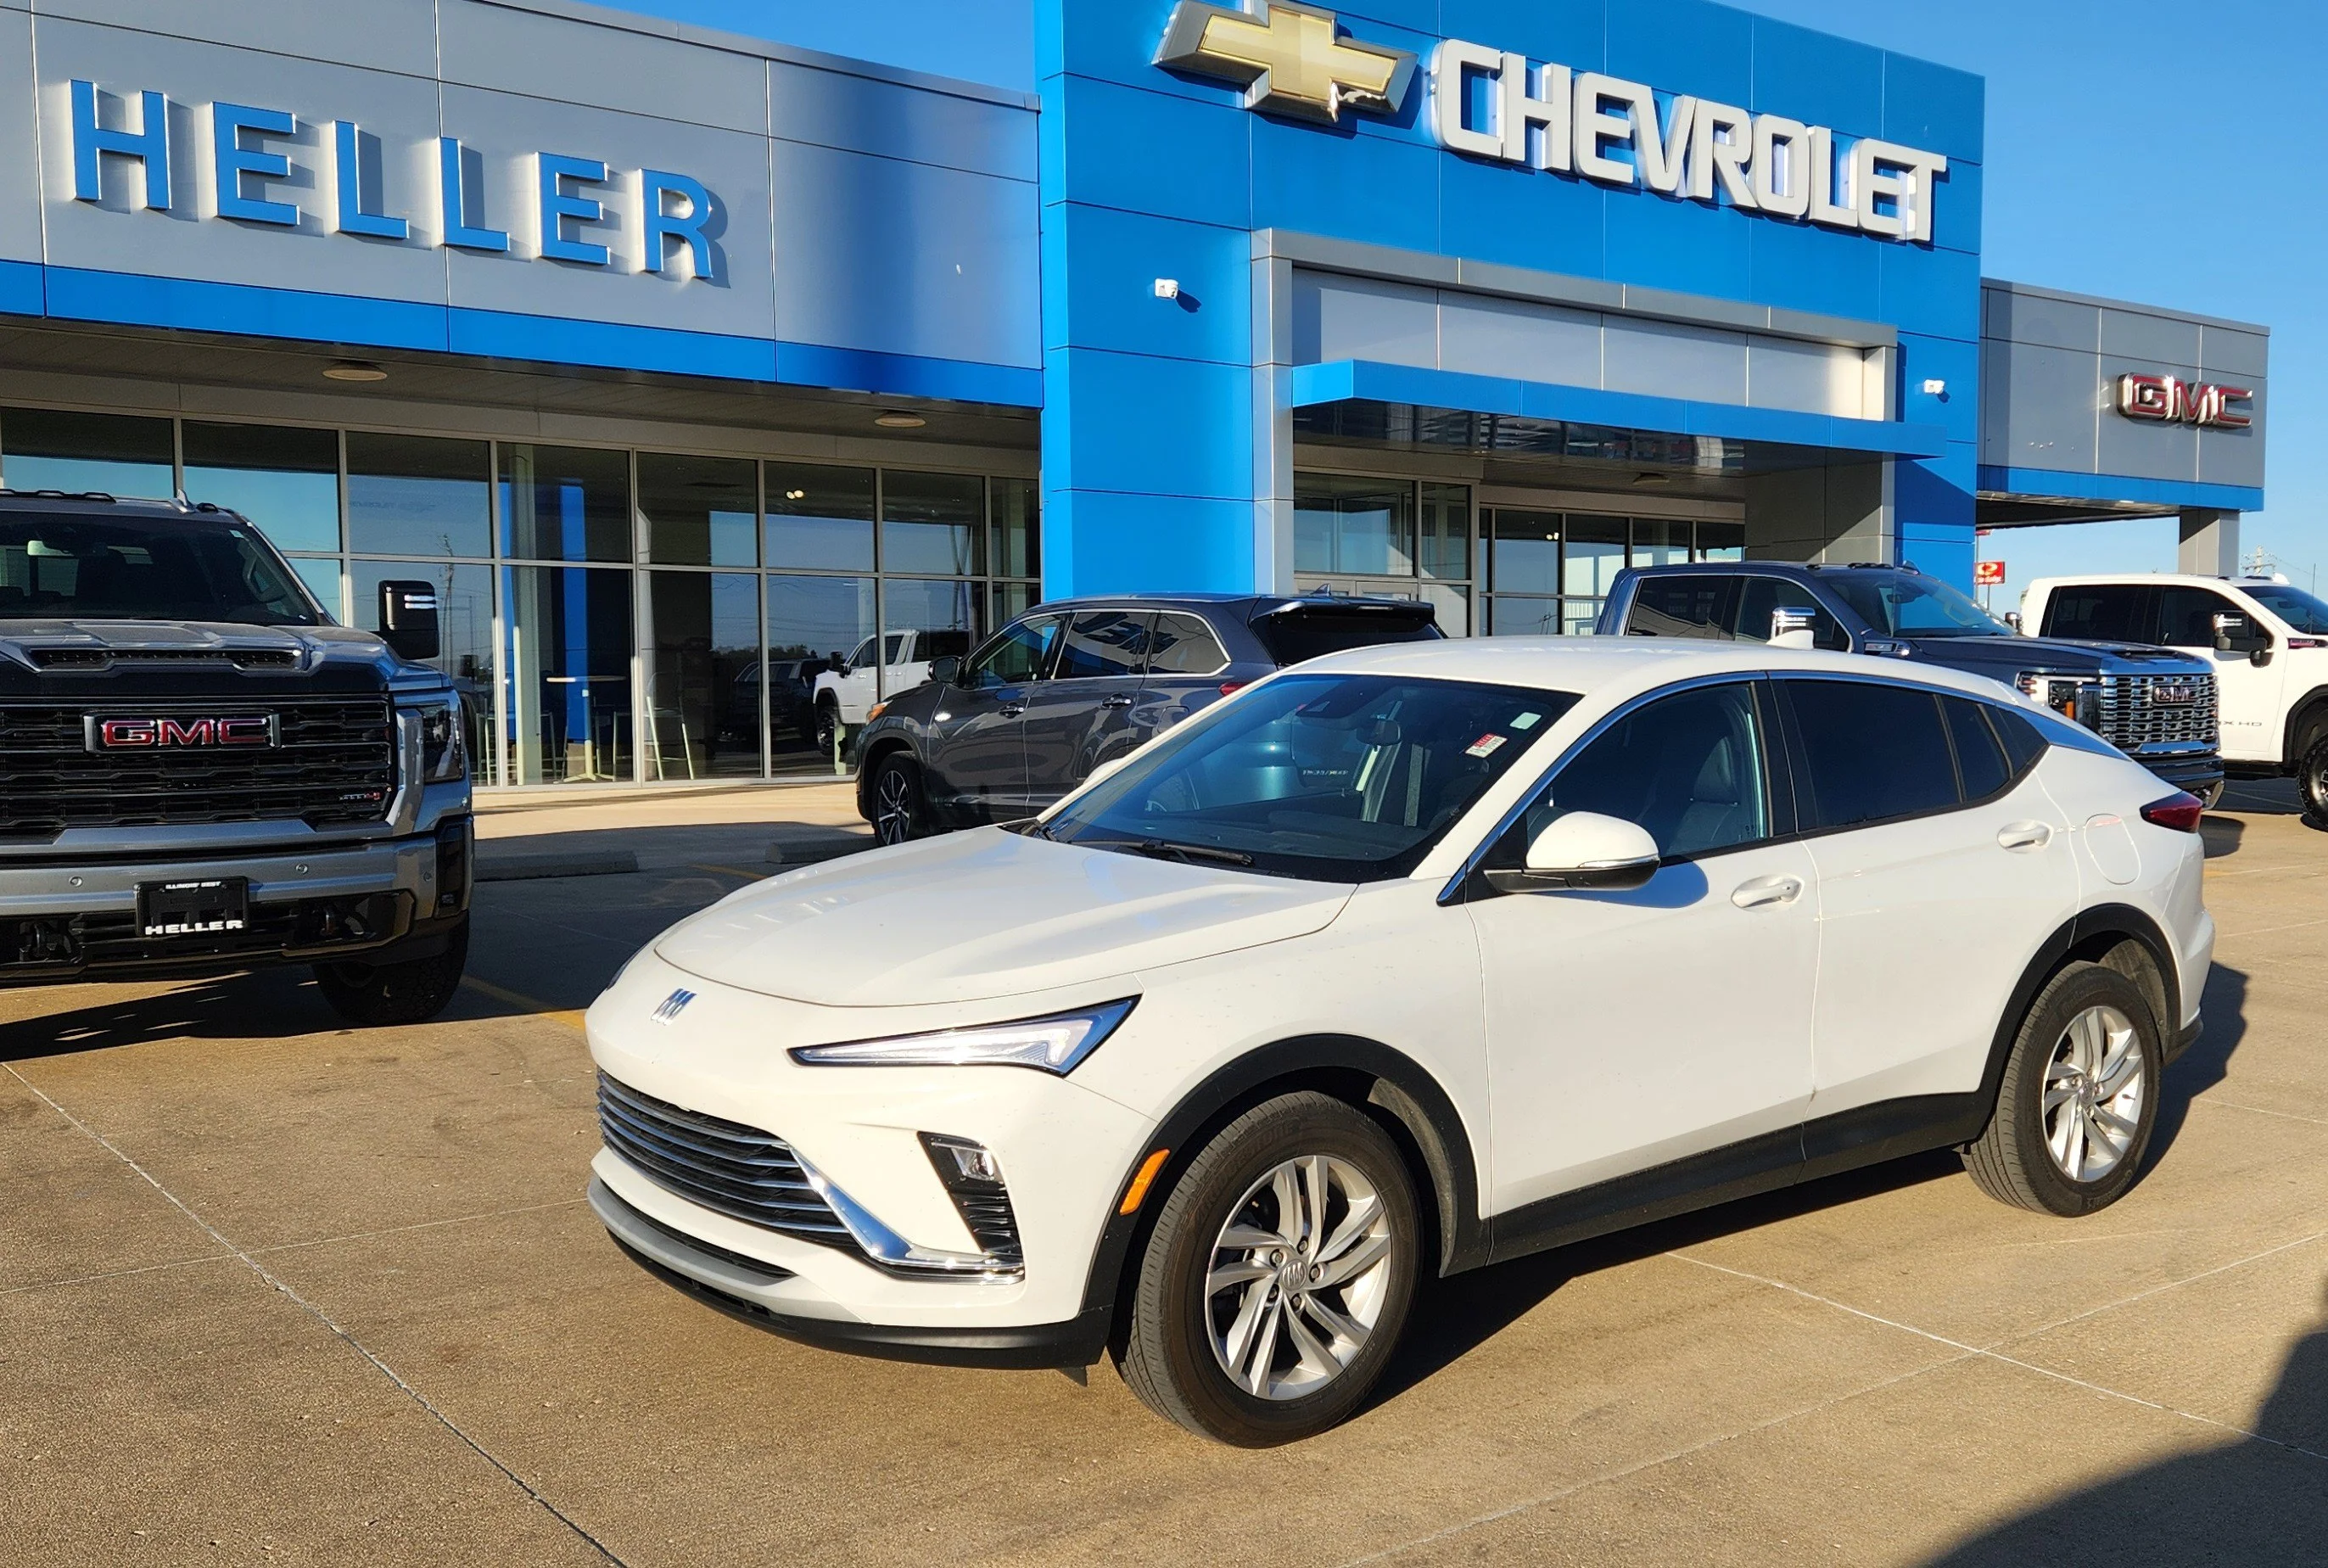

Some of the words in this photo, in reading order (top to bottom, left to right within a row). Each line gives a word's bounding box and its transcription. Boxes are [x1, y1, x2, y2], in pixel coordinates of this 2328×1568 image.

[1431, 38, 1947, 243] CHEVROLET
[70, 79, 714, 280] HELLER
[2118, 372, 2253, 427] GMC
[2155, 686, 2198, 702] GMC
[101, 718, 268, 748] GMC
[145, 920, 243, 935] HELLER
